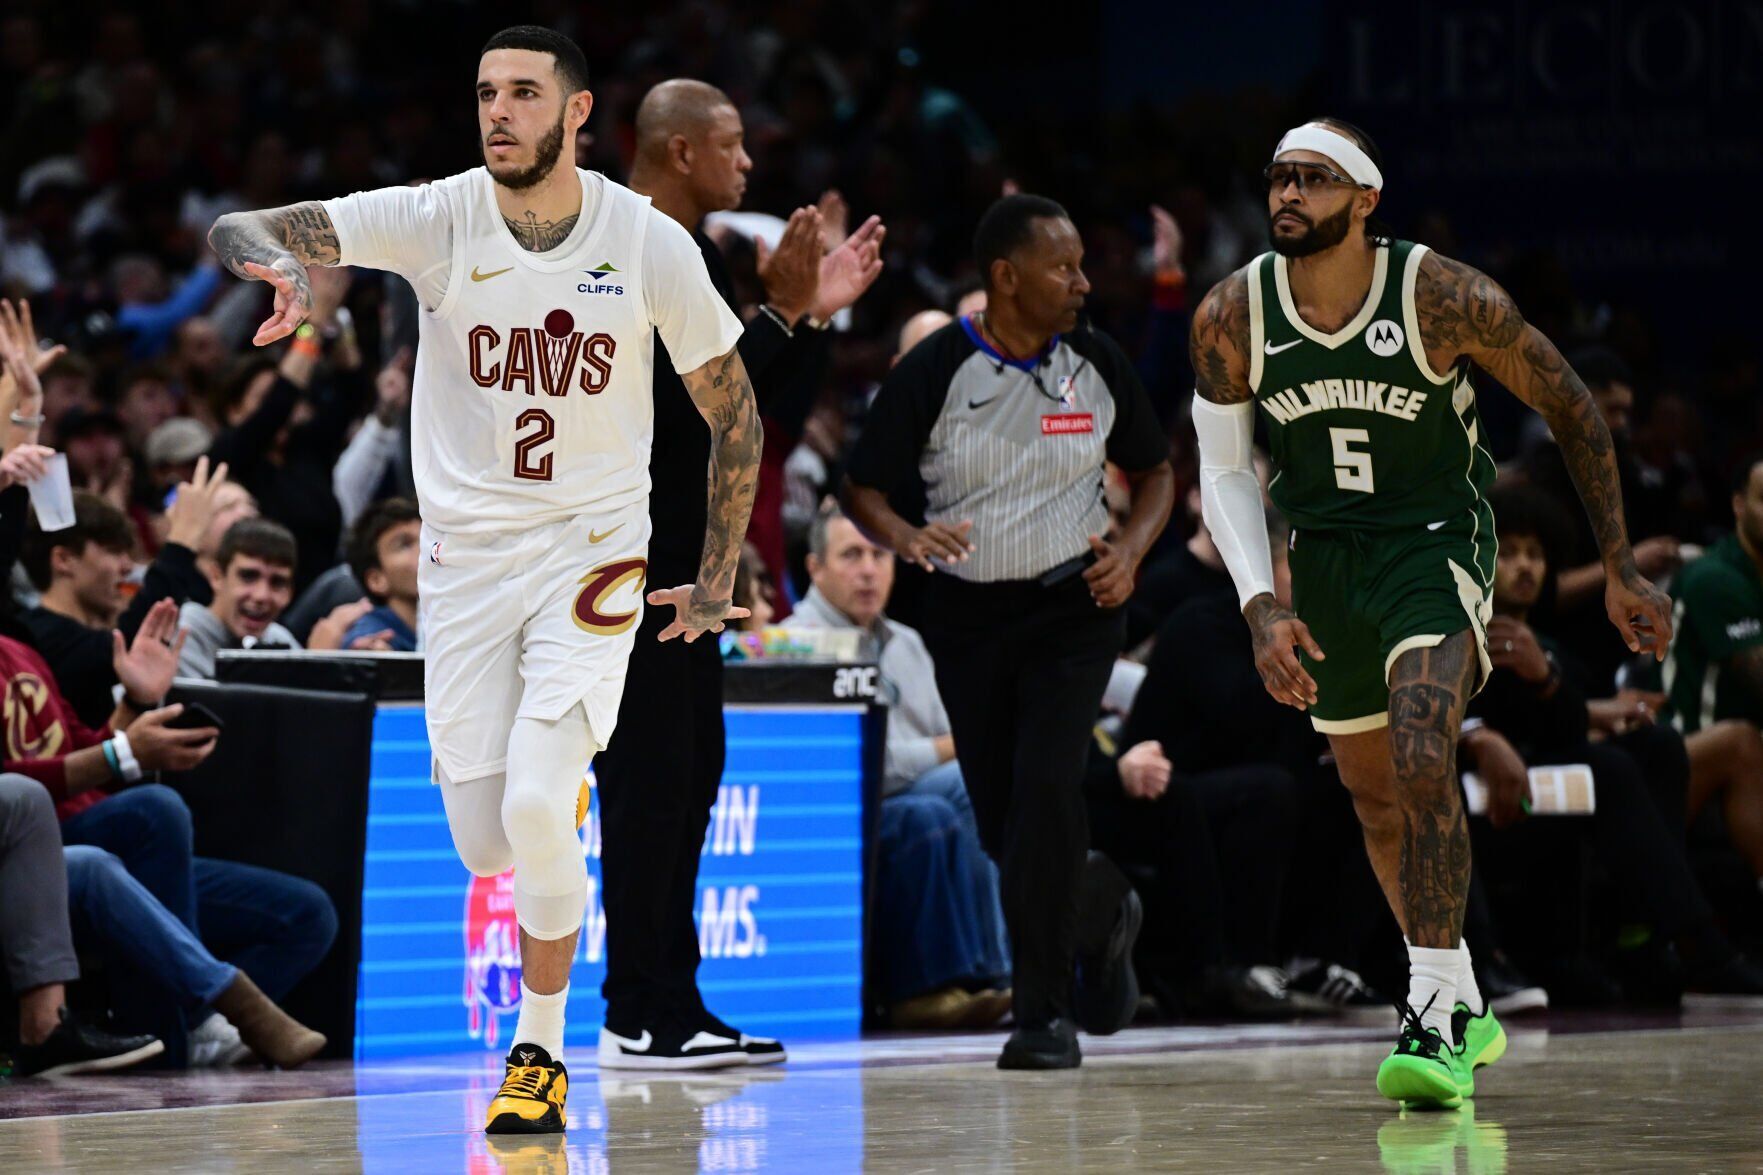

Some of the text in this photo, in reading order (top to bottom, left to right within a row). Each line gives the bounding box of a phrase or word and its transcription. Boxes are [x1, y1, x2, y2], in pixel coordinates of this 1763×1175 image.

[577, 283, 624, 295] CLIFFS
[468, 320, 617, 397] CAVS
[1042, 416, 1092, 432] Emirates
[1261, 378, 1428, 425] MILWAUKEE
[514, 408, 555, 481] 2
[1329, 427, 1374, 494] 5
